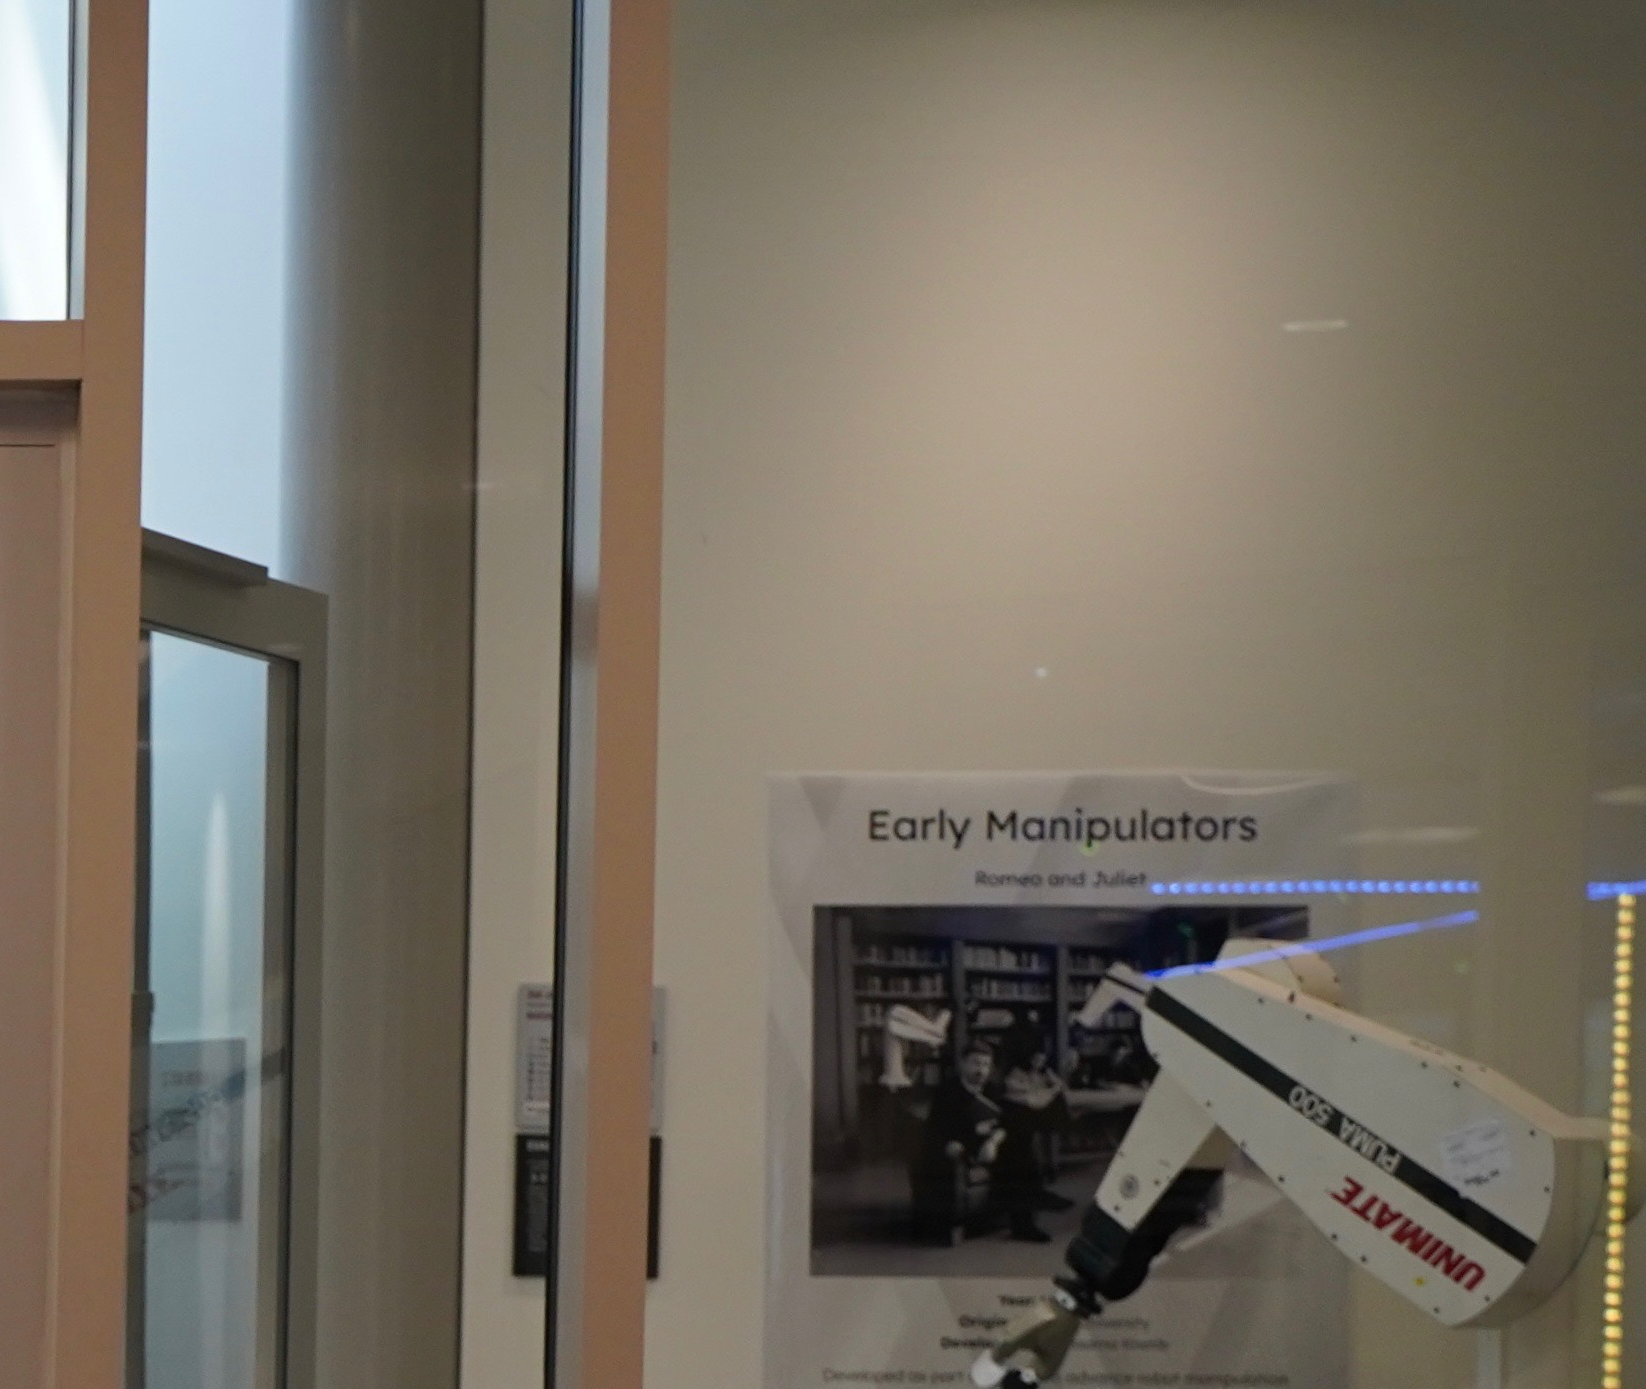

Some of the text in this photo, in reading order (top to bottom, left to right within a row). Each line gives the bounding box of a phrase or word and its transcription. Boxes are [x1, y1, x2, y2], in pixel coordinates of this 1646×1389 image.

[868, 807, 1259, 849] Early Manipulators
[974, 870, 1147, 887] Romeo and Juliet
[1288, 1085, 1335, 1127] 500
[1338, 1117, 1403, 1175] PUMA
[1330, 1175, 1488, 1292] UNIMATE
